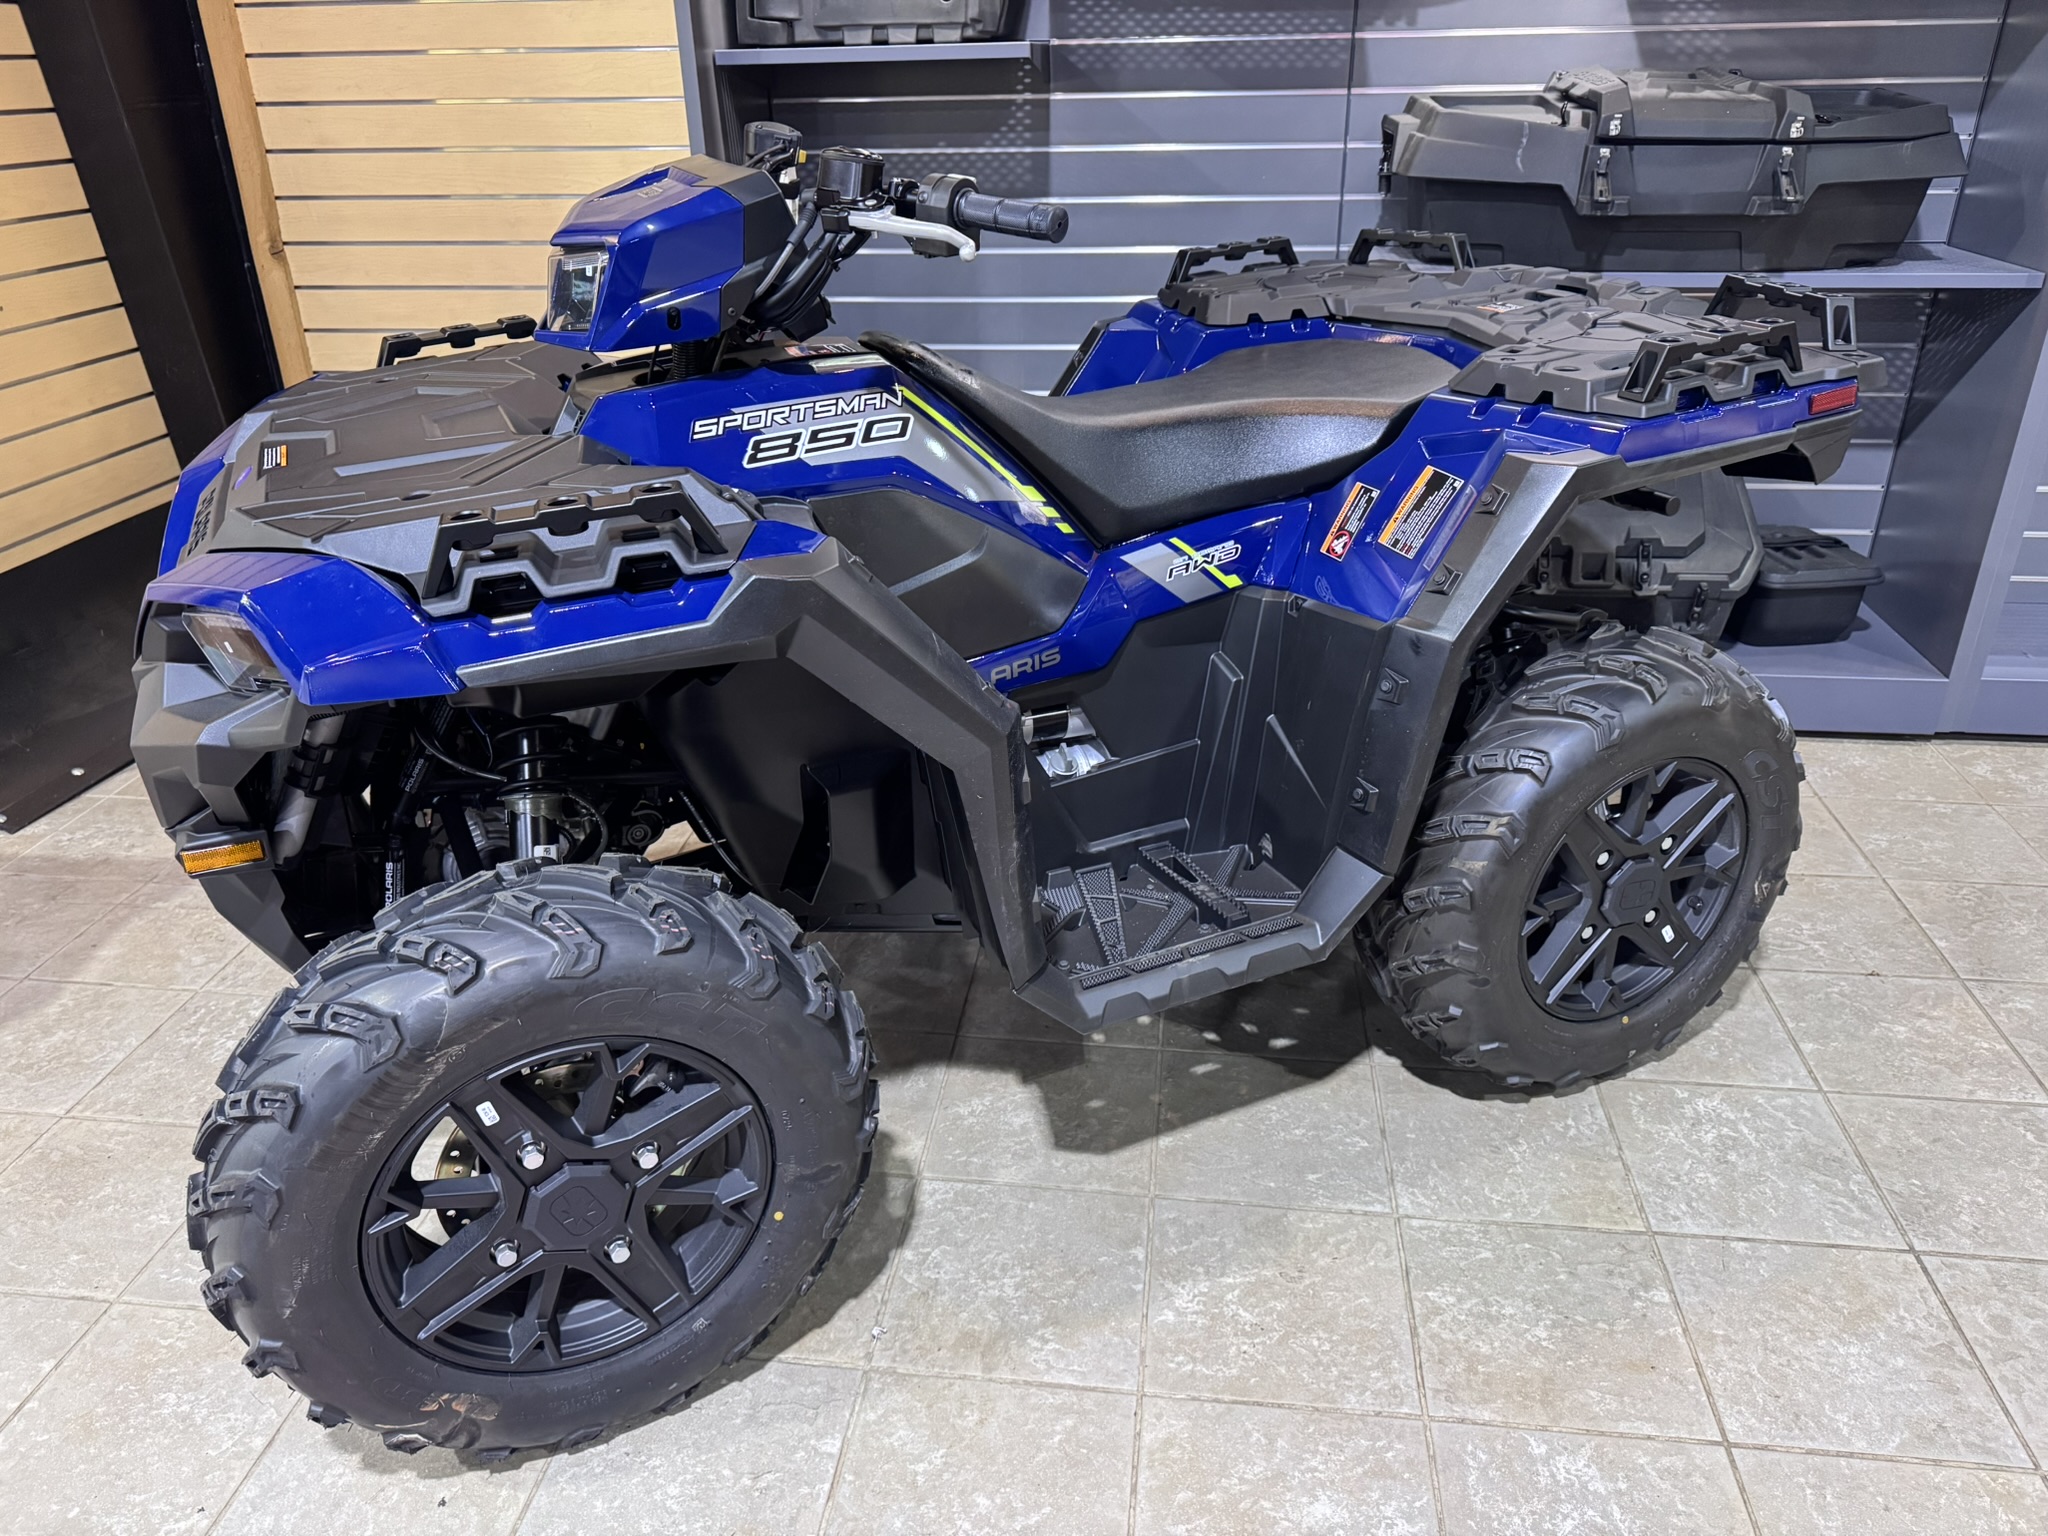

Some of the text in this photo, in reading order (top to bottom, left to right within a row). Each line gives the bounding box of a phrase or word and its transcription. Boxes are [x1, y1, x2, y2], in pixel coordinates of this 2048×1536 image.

[691, 390, 903, 441] SPORTSMAN
[742, 413, 914, 469] 850
[1397, 484, 1420, 518] WARNING
[1166, 544, 1242, 582] AWD
[405, 758, 425, 792] POLARIS
[385, 862, 394, 908] POLARIS
